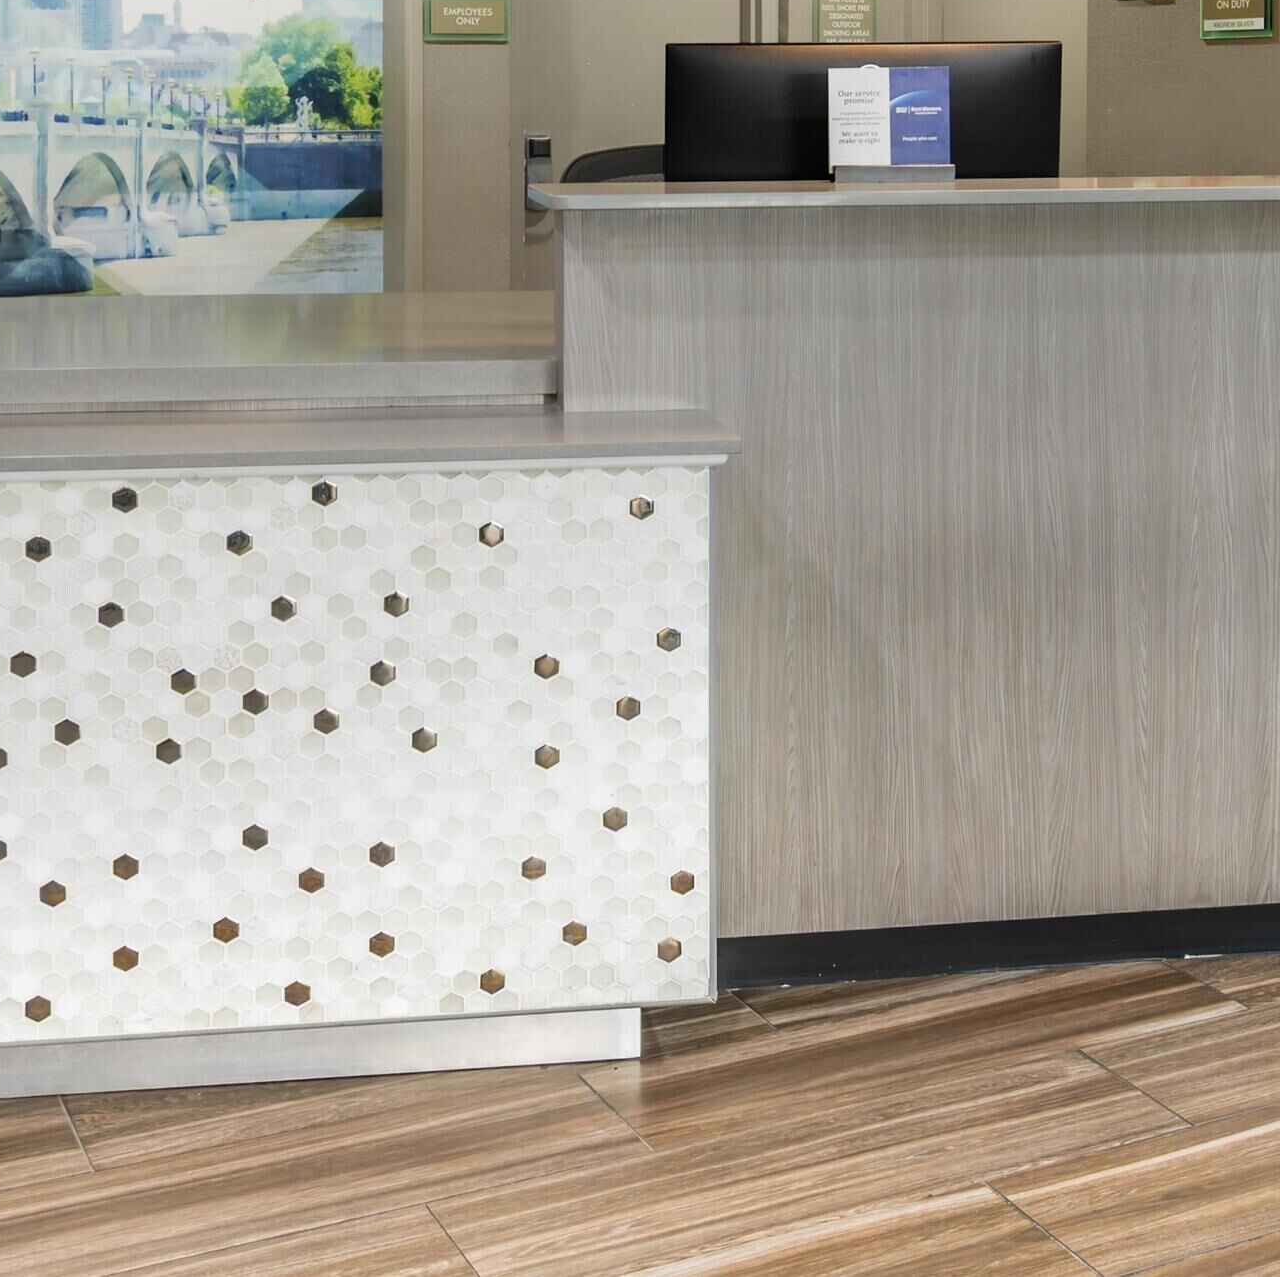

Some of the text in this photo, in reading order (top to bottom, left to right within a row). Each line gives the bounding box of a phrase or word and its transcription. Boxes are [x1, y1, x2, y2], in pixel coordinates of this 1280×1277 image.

[1217, 0, 1250, 9] ON DUTY
[443, 7, 493, 16] EMPLOYEES
[456, 17, 480, 25] ONLY
